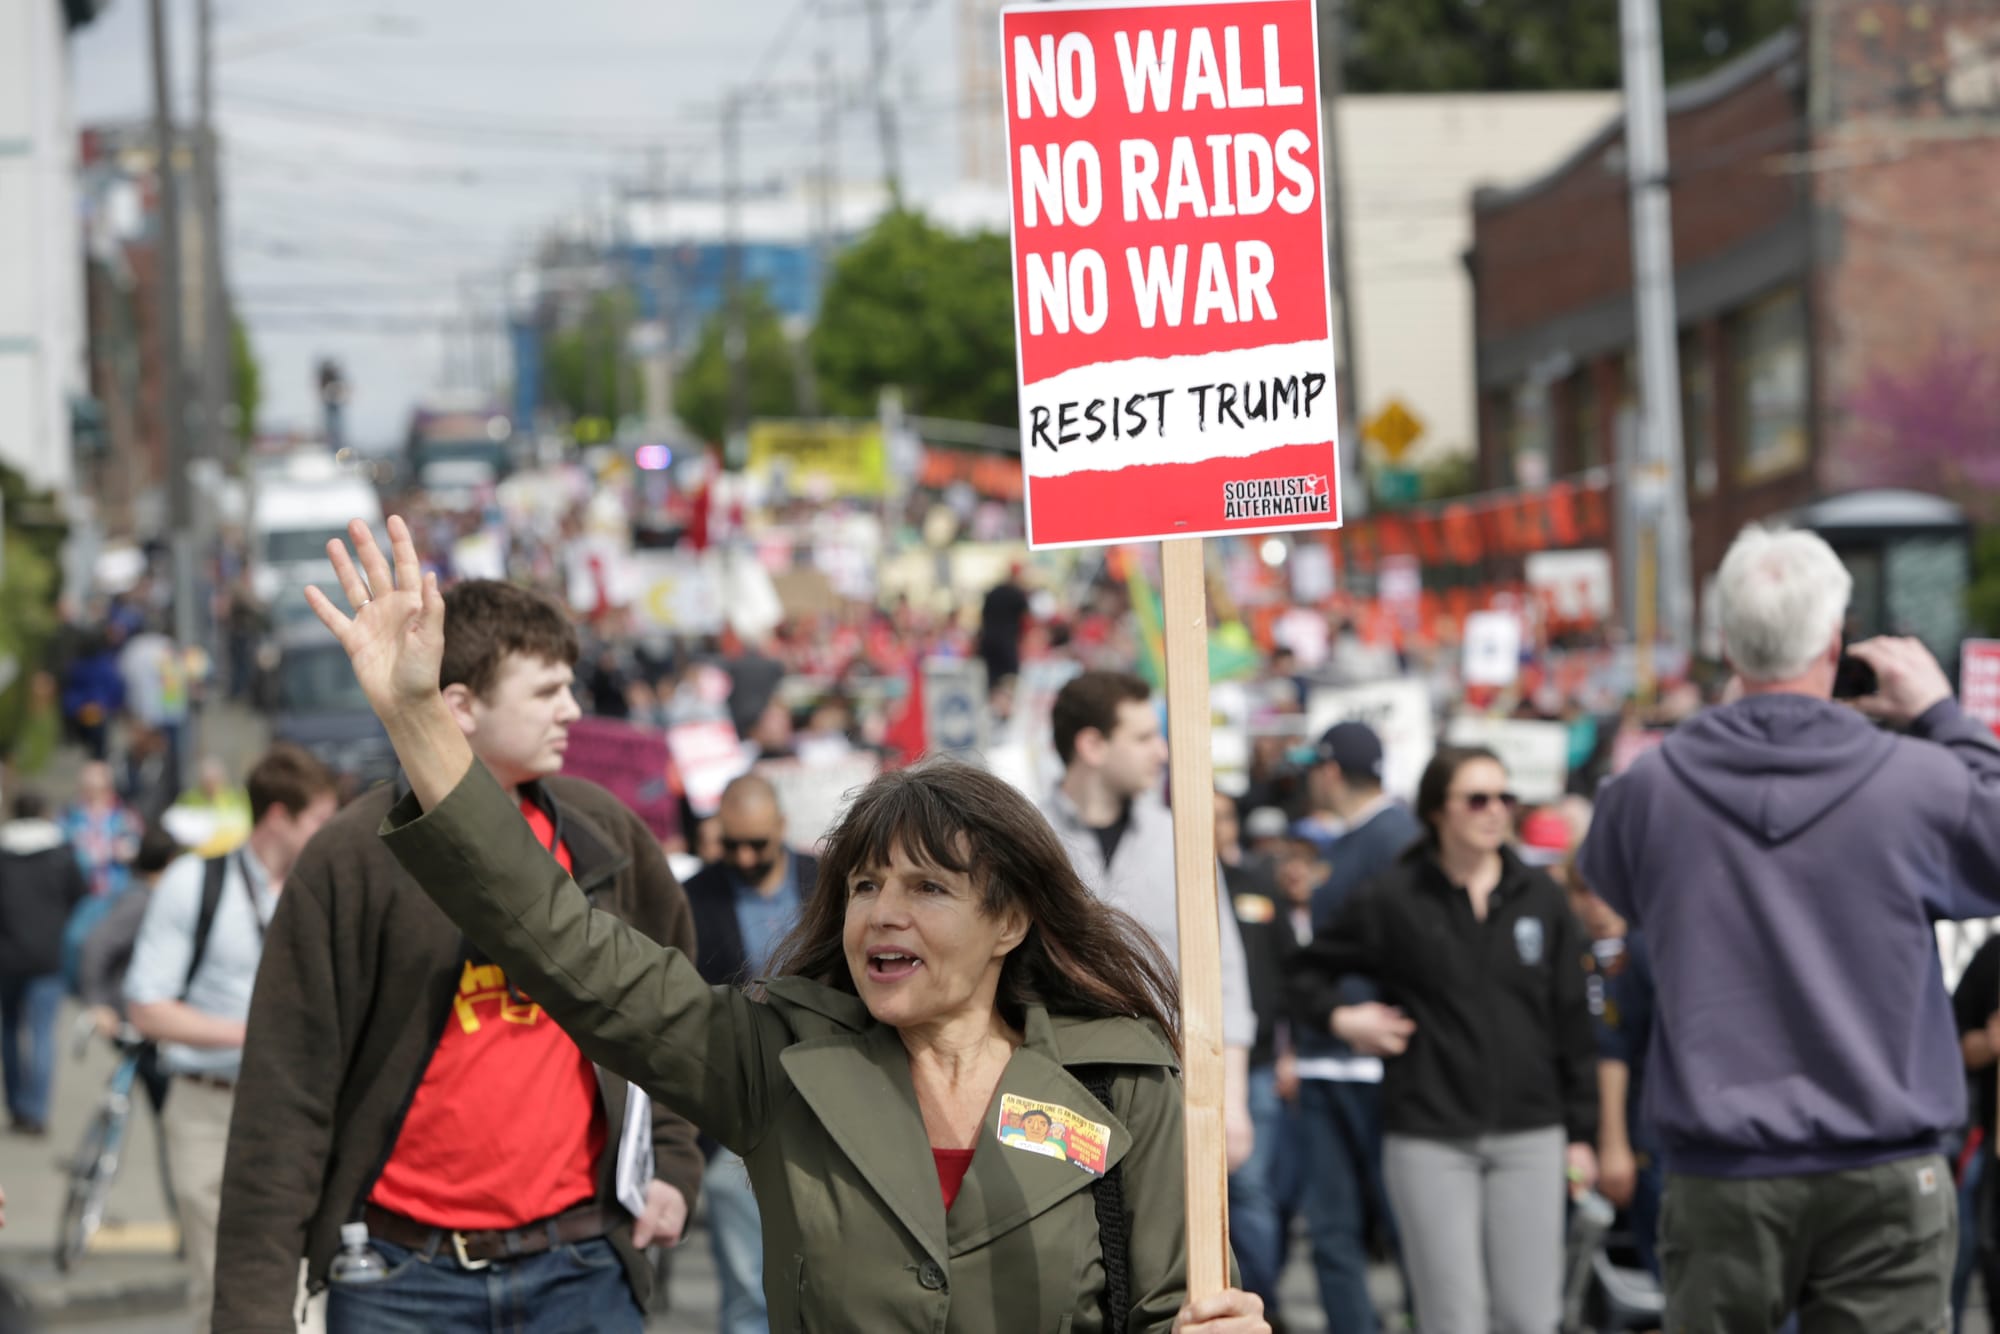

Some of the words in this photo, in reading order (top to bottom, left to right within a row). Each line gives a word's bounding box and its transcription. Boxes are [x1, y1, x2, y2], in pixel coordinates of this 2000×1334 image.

[1014, 32, 1097, 119] NO
[1114, 24, 1303, 113] WALL
[1020, 140, 1102, 228] NO
[1119, 129, 1315, 222] RAIDS
[1026, 248, 1108, 336] NO
[1125, 240, 1278, 328] WAR
[1030, 389, 1174, 452] RESIST
[1187, 371, 1326, 432] TRUMP
[1225, 478, 1305, 501] SOCIALIST
[1225, 494, 1328, 518] ALTERNATIVE
